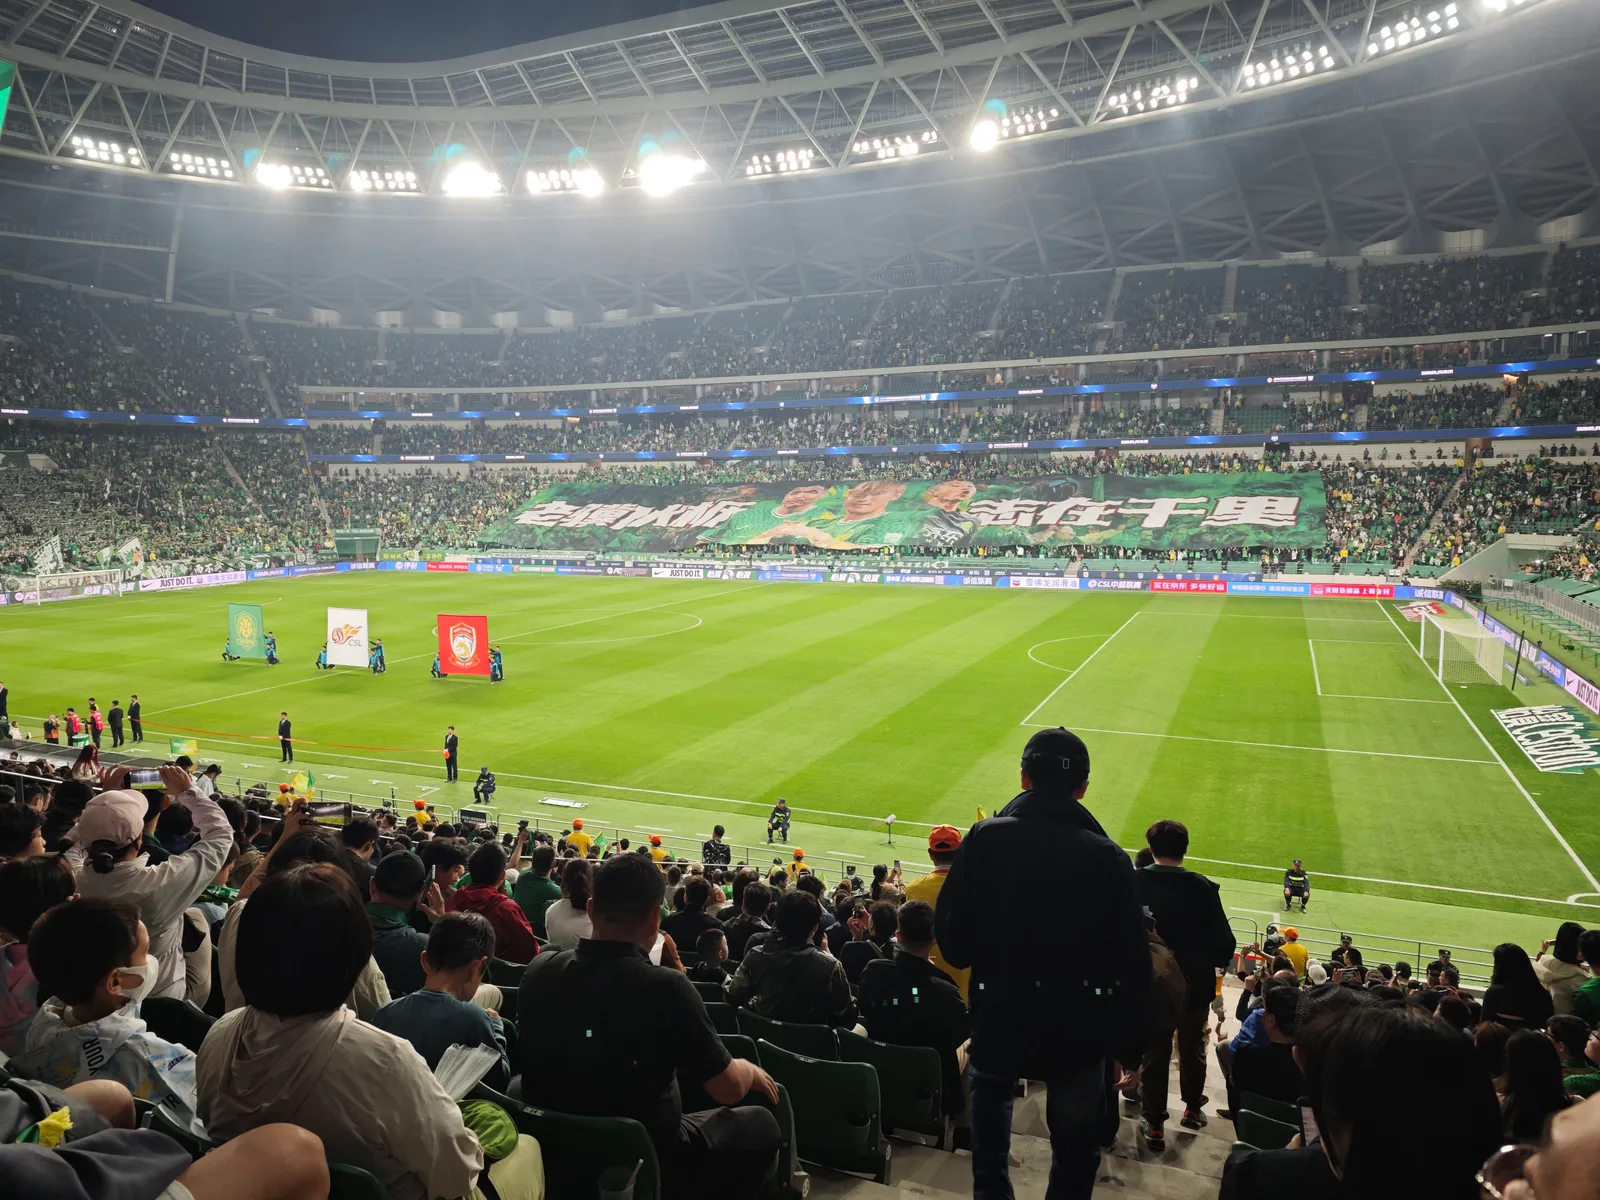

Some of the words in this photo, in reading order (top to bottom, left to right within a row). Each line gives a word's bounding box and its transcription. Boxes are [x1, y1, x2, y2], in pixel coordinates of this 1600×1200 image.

[967, 494, 1302, 528] 志在千里
[669, 569, 684, 577] JUST
[160, 578, 175, 587] JUST
[175, 578, 186, 586] DO
[186, 577, 194, 585] IT.
[1025, 578, 1078, 588] 雪佛龙润滑油
[1153, 581, 1188, 590] 买在京东
[1190, 582, 1225, 591] 多快好省
[348, 639, 363, 647] CSL
[1576, 679, 1587, 701] JUST
[83, 1037, 105, 1077] YOUR
